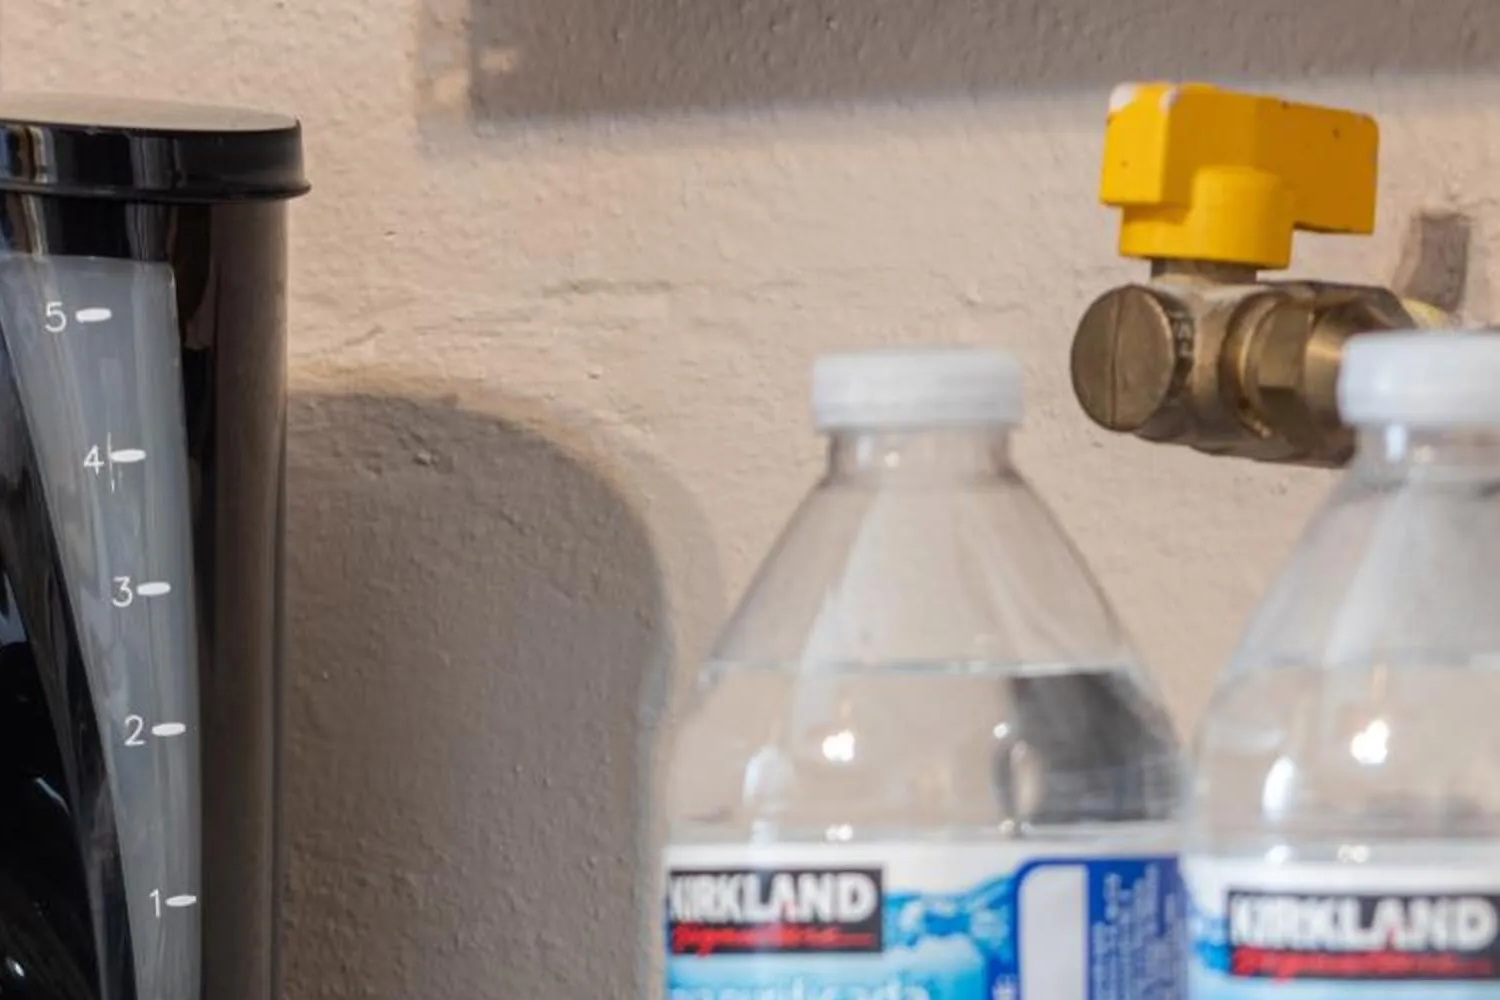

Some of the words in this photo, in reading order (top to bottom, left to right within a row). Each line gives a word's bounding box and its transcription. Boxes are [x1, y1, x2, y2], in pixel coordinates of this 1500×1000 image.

[44, 301, 67, 332] 5
[83, 444, 105, 477] 4
[112, 575, 134, 608] 3
[124, 714, 146, 746] 2
[149, 888, 161, 918] 1
[669, 872, 878, 924] KIRKLAND
[1230, 894, 1498, 950] KIRKLAND
